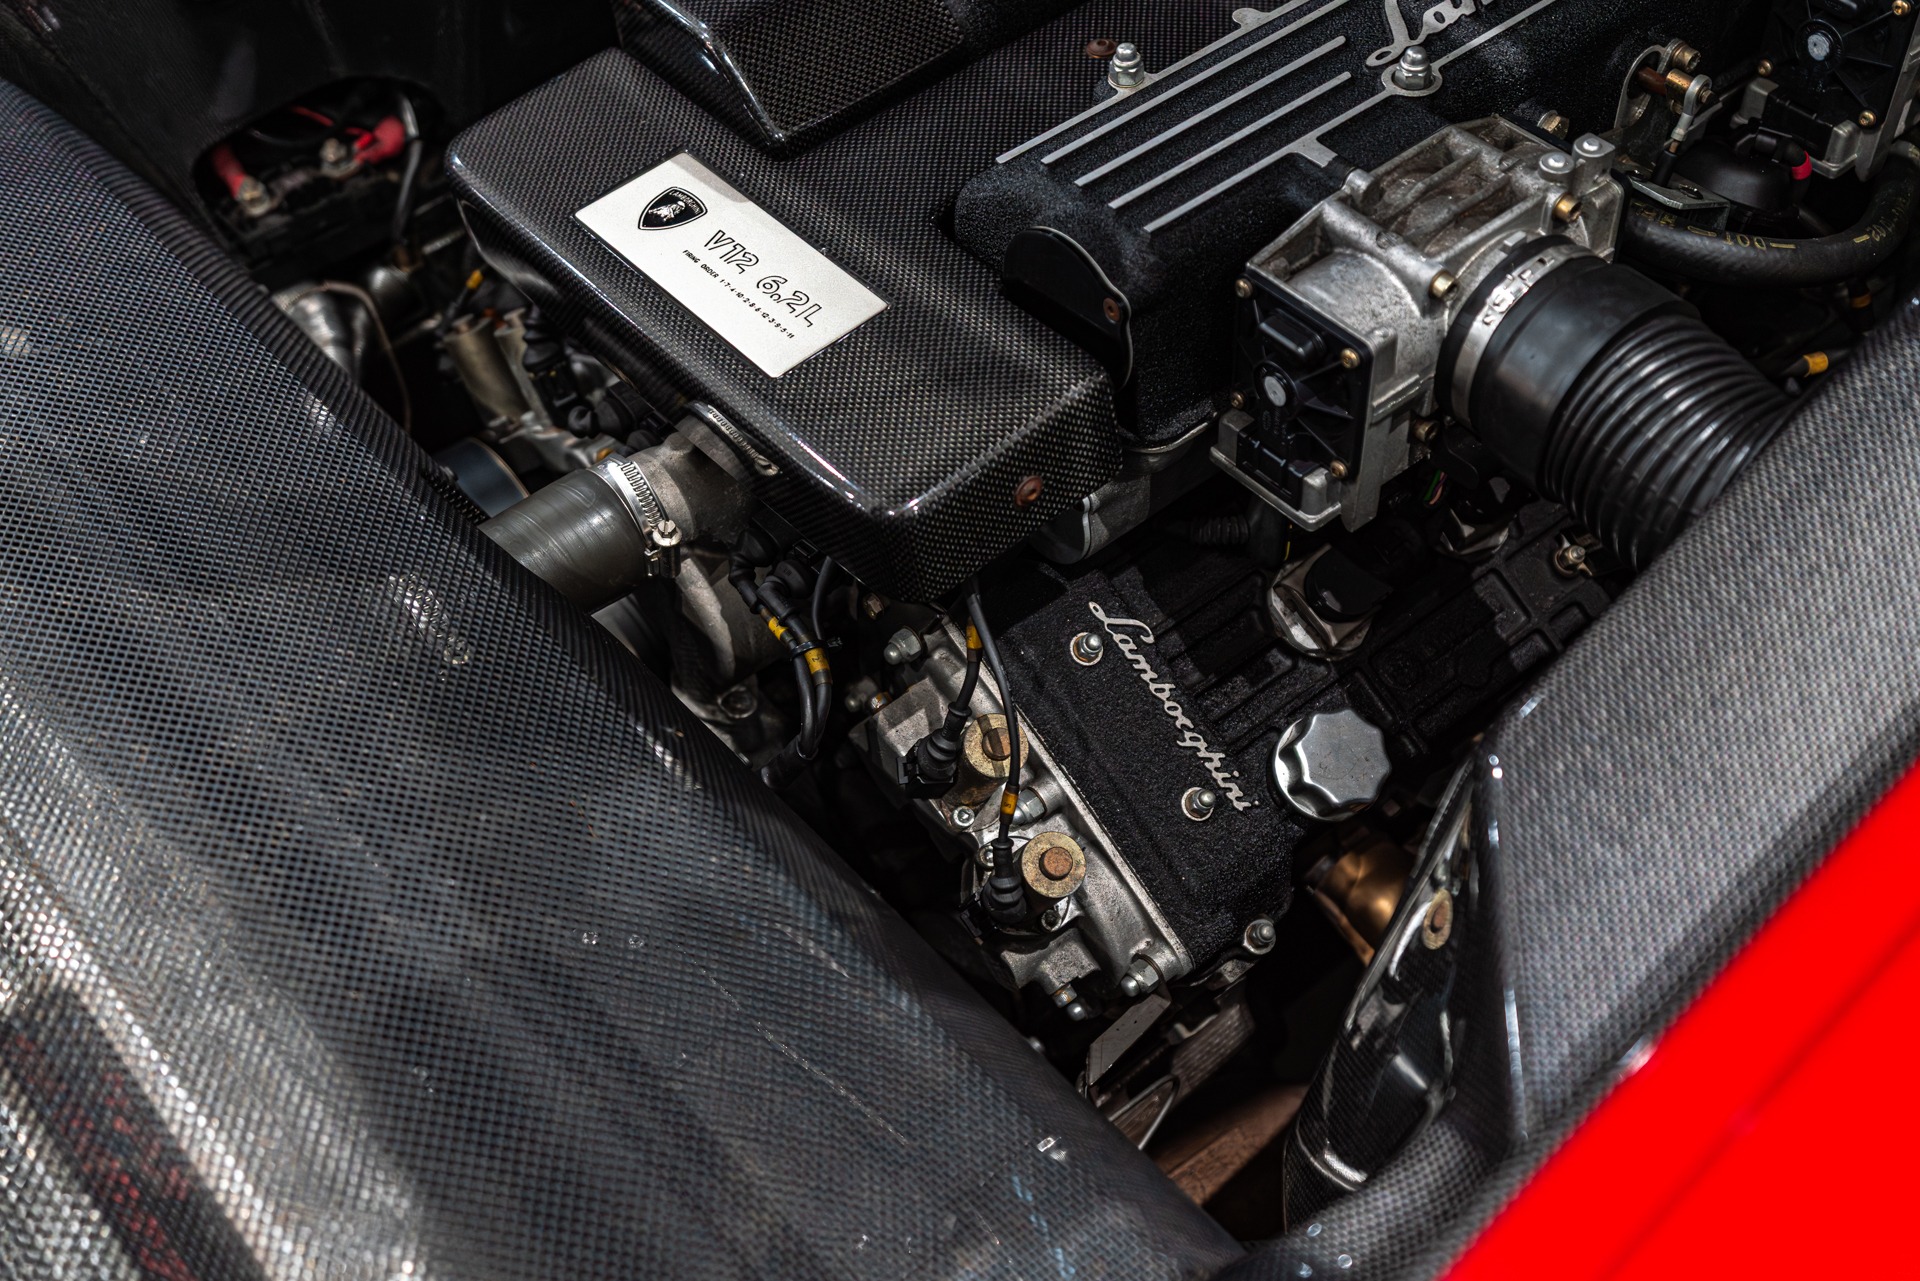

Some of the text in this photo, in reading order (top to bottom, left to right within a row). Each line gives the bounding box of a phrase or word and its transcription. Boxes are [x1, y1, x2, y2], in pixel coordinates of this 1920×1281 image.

[682, 249, 701, 263] FIRING
[700, 263, 720, 279] ORDER
[703, 229, 822, 328] V12 6.2L
[1088, 601, 1259, 811] Lamborghini
